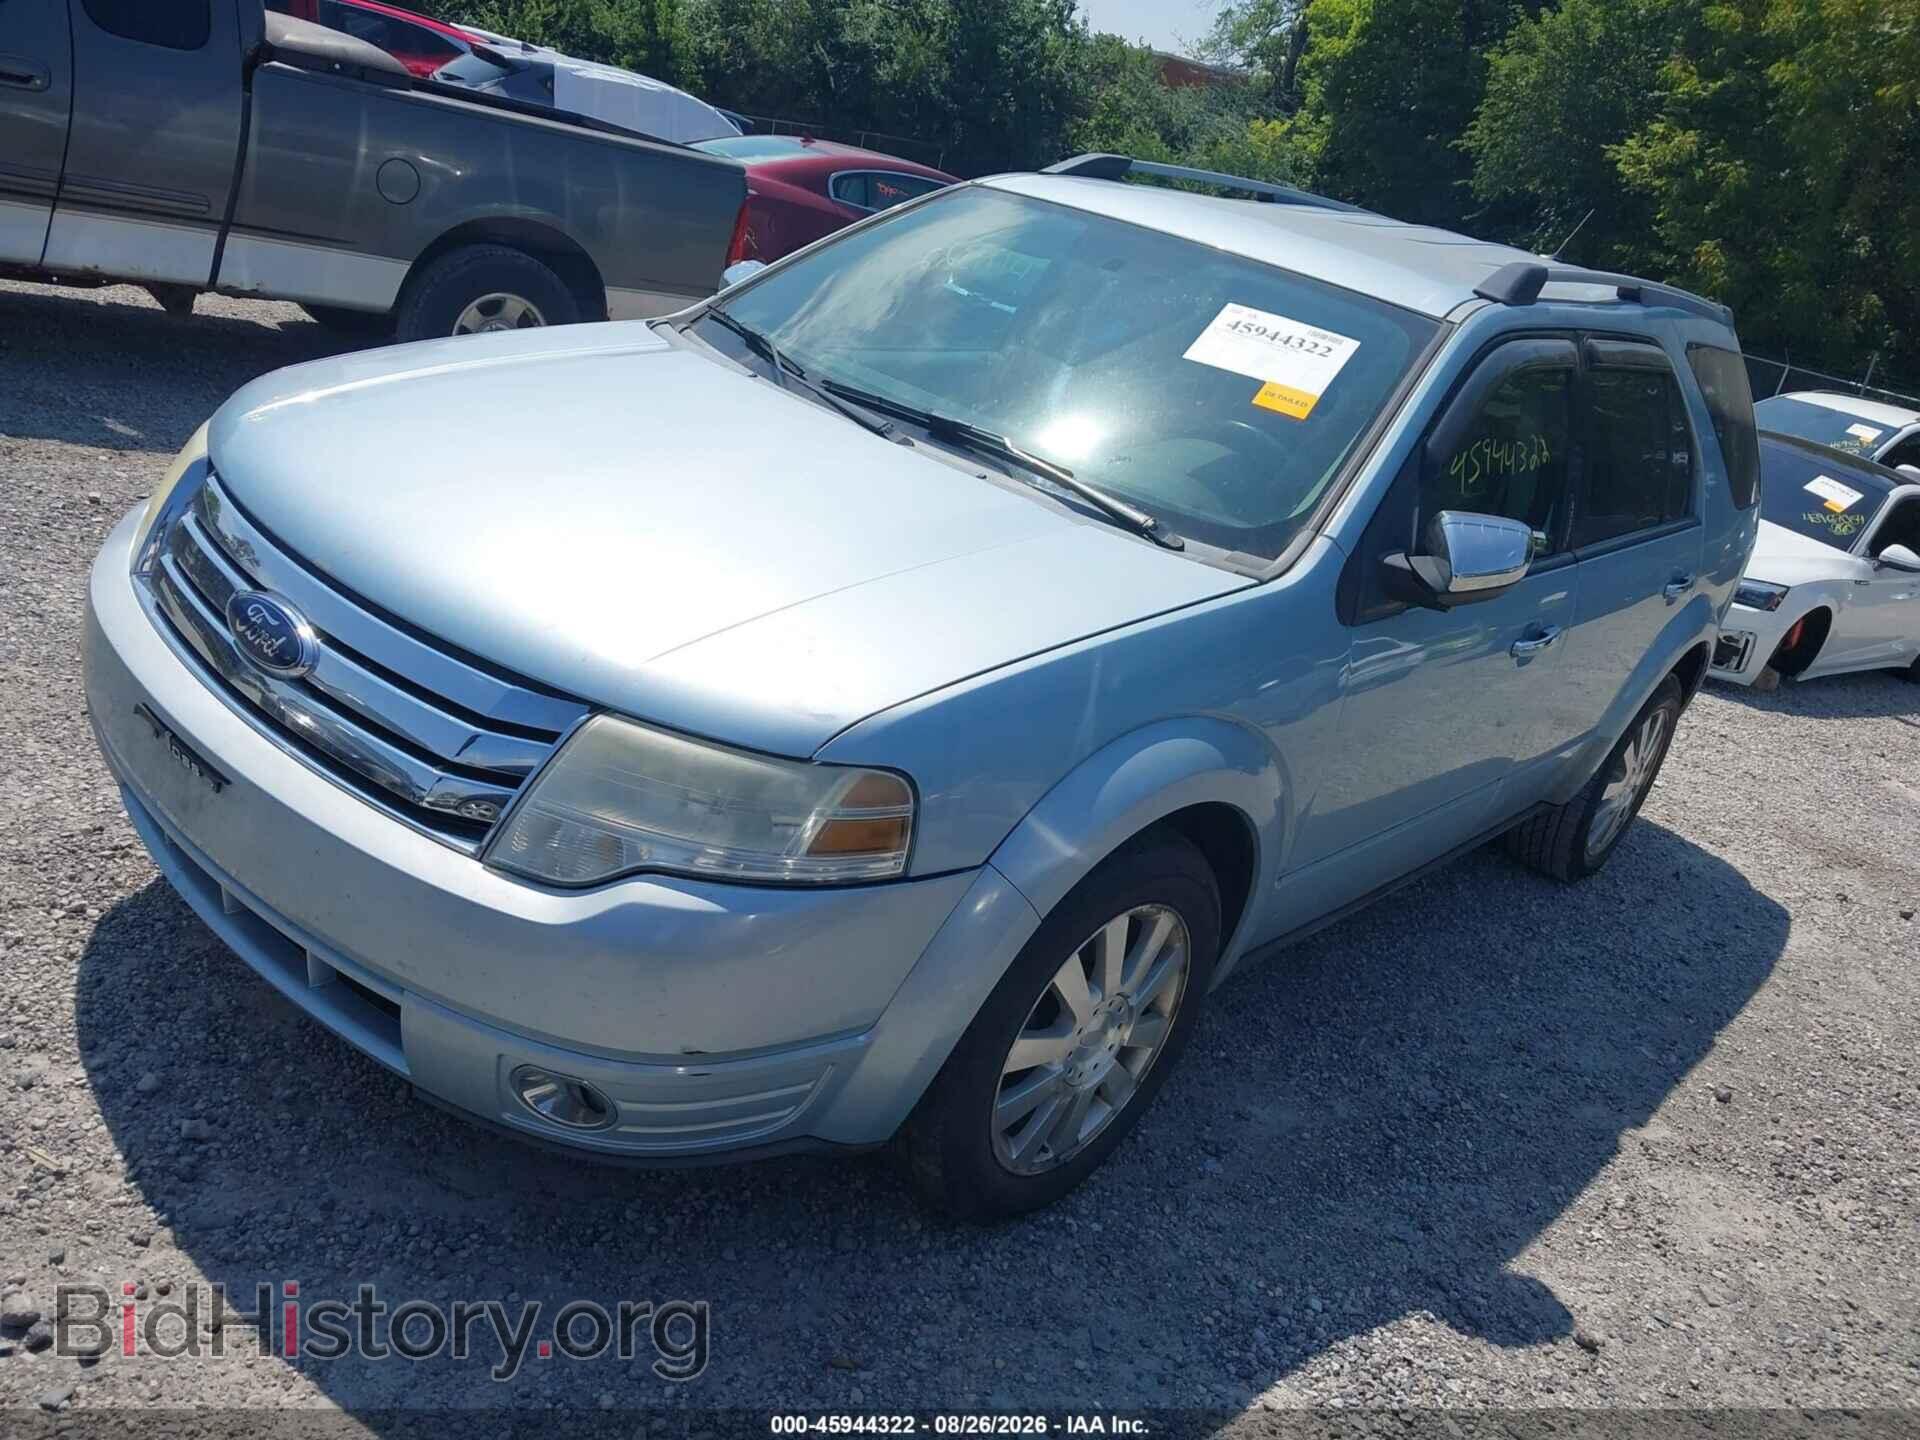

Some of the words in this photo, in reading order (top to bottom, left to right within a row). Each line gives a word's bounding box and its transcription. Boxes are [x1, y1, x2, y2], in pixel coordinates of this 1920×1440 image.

[1225, 320, 1333, 358] 45944322
[1263, 389, 1309, 408] DETAILED
[1450, 434, 1550, 494] 45944322
[235, 603, 287, 657] Ford
